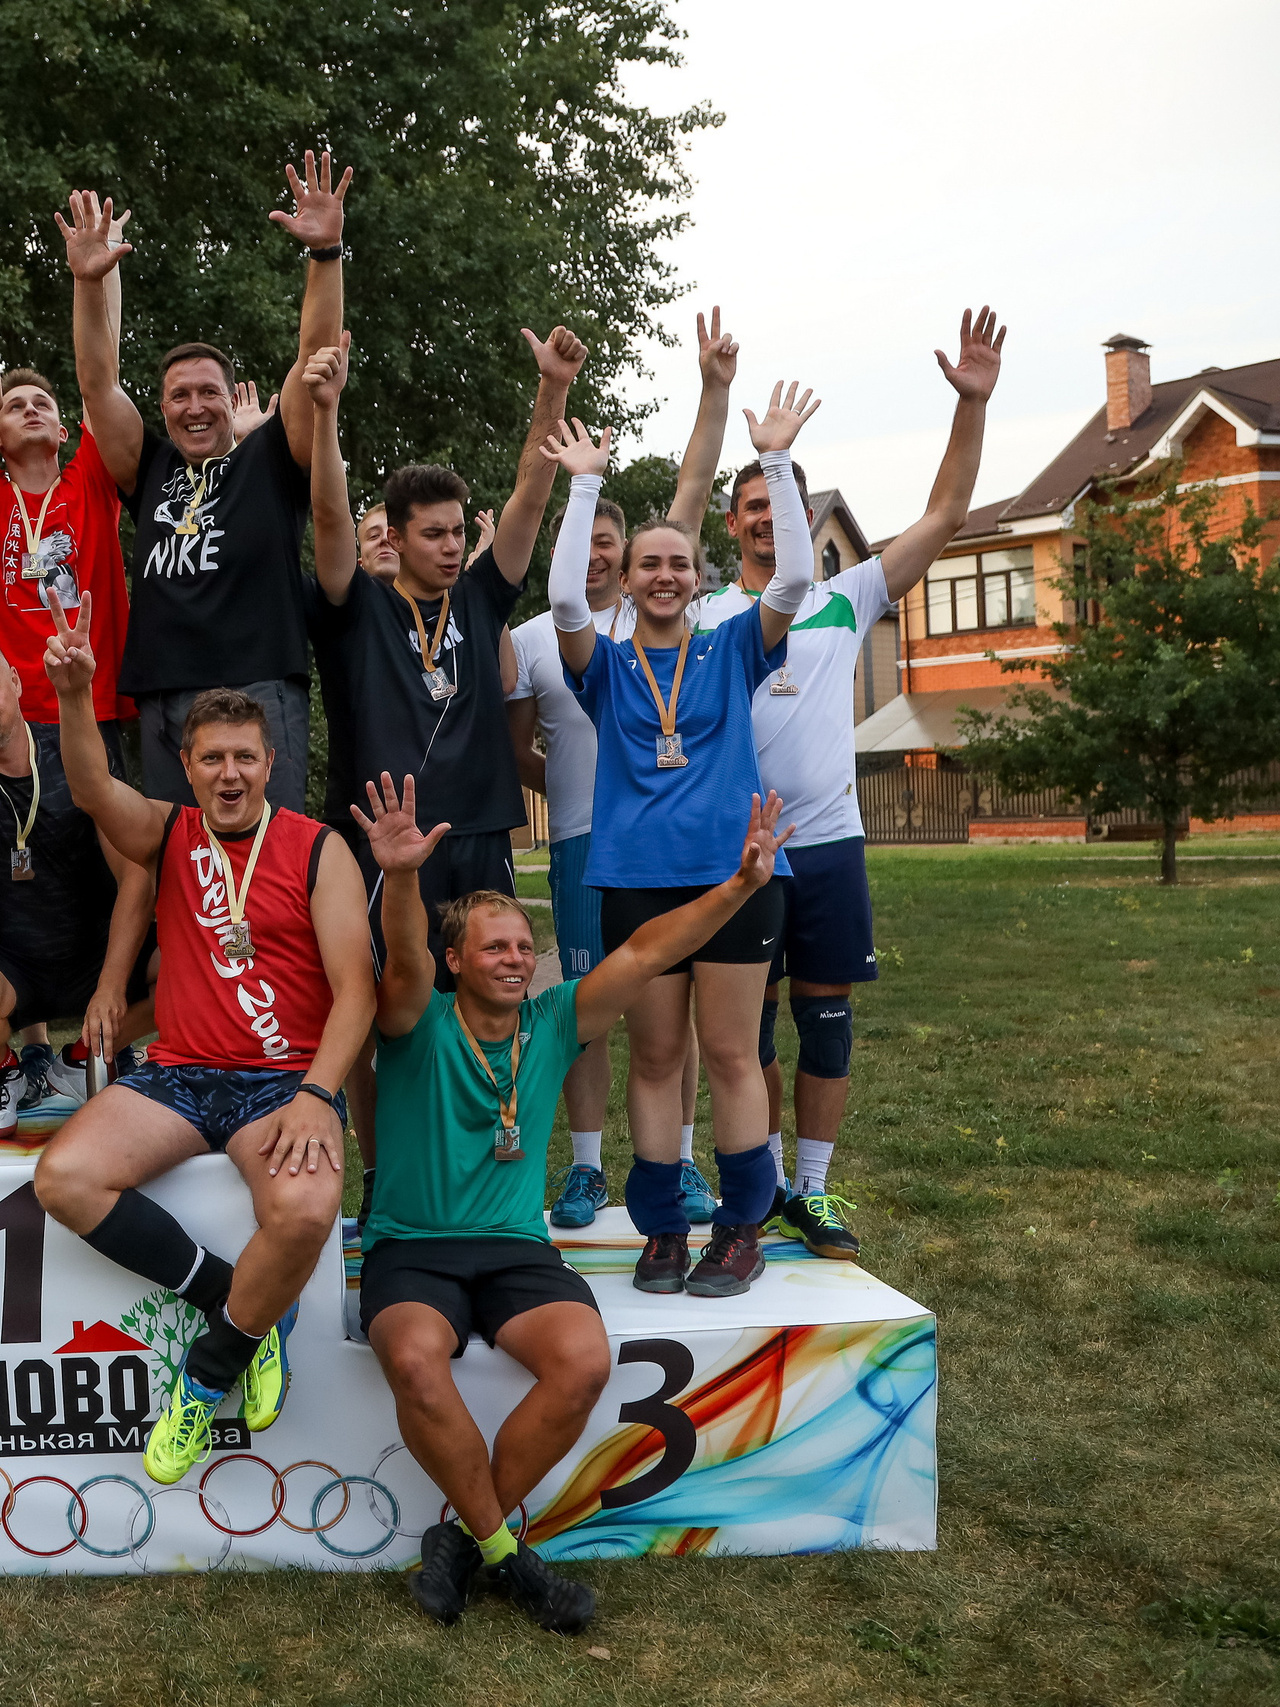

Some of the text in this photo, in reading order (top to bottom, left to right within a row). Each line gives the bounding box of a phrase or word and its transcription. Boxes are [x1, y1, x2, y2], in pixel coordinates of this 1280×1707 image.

[143, 529, 225, 579] NIKE
[569, 948, 590, 973] 10
[108, 1426, 242, 1449] Мва
[600, 1338, 697, 1510] 3
